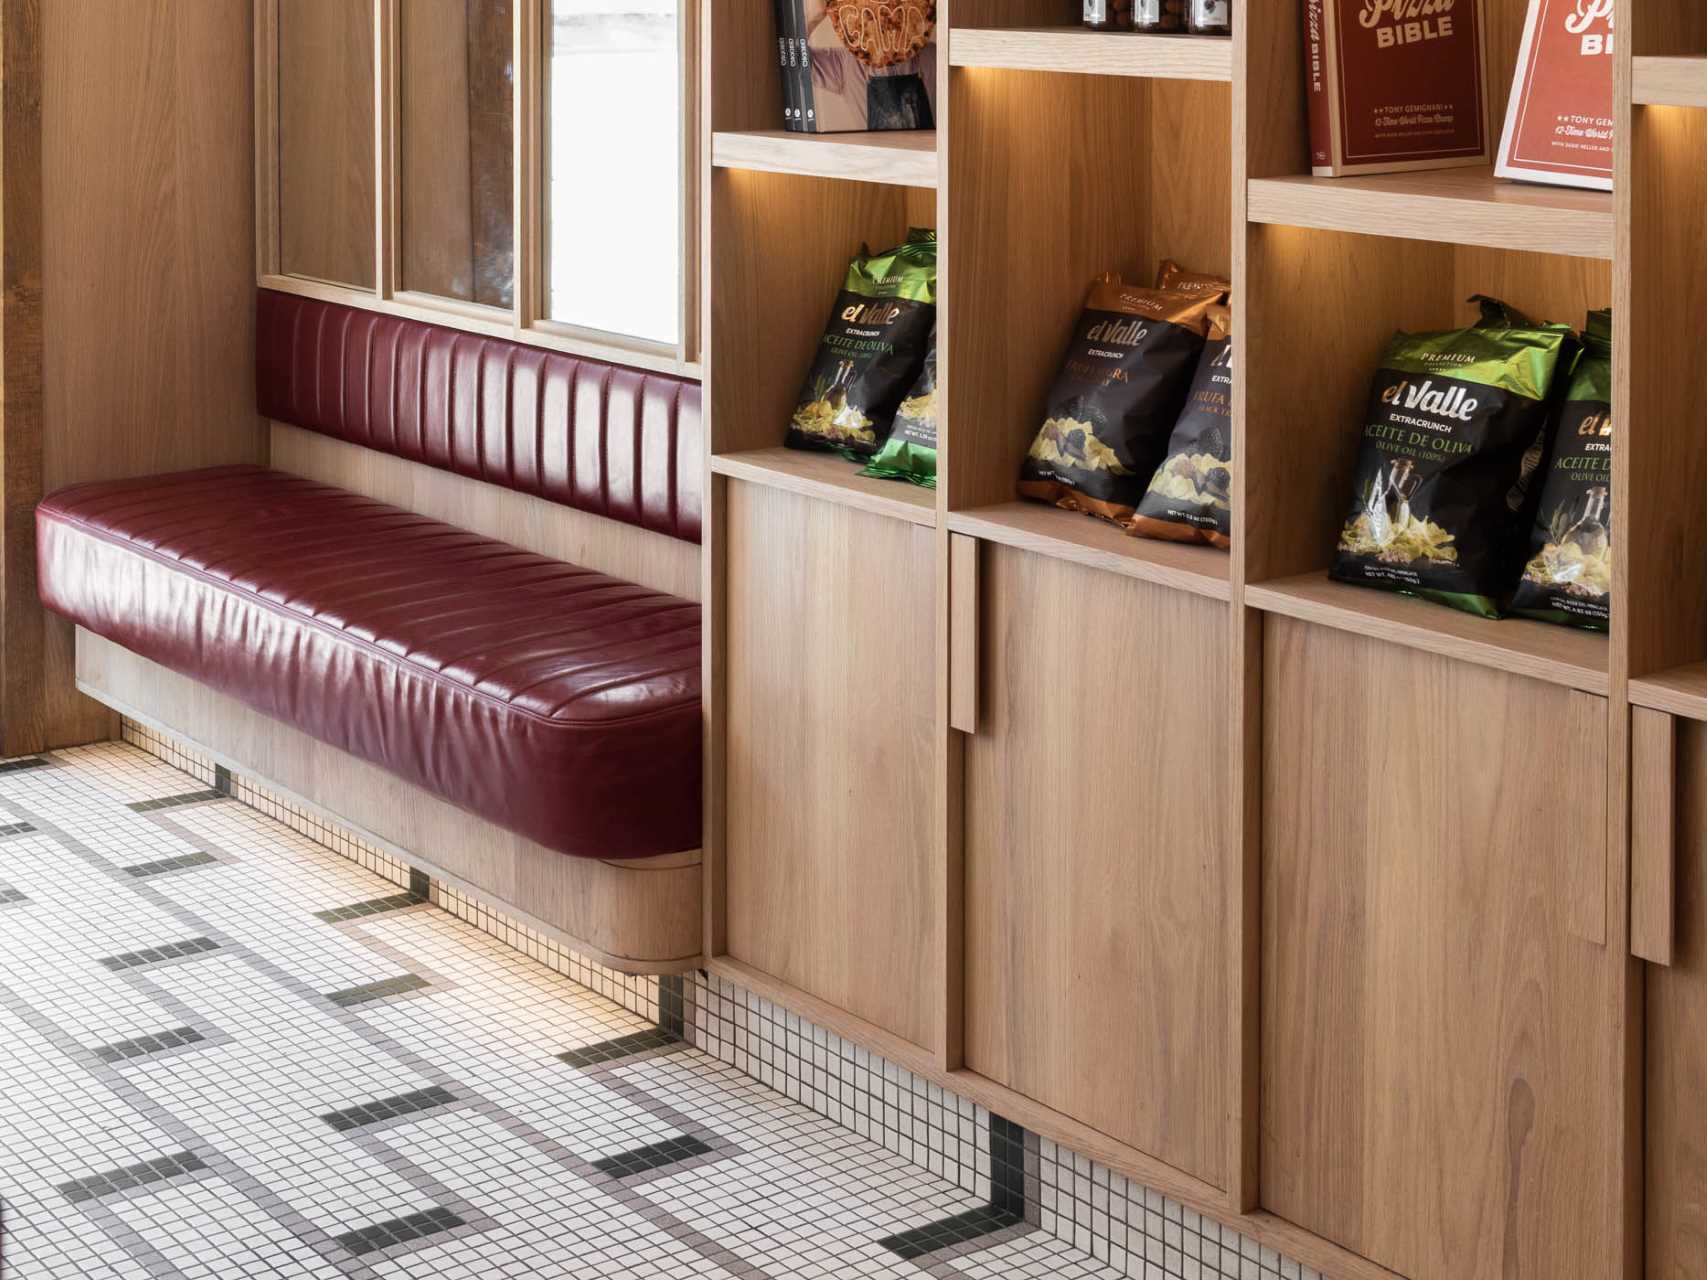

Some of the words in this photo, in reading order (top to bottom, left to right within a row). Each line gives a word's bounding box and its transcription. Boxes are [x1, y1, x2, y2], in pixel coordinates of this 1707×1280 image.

[838, 4, 926, 54] CAMP
[1376, 16, 1453, 49] BIBLE
[1311, 42, 1322, 94] BIBLE
[1384, 106, 1404, 114] TONY
[1571, 115, 1594, 124] TONY
[841, 303, 865, 322] el
[1087, 320, 1109, 341] el
[1104, 319, 1148, 347] Valle
[1421, 351, 1477, 363] PREMIUM
[1381, 380, 1409, 406] el
[1404, 380, 1479, 422] Valle
[1389, 412, 1453, 434] EXTRACRUNCH
[1578, 416, 1600, 435] el
[1408, 431, 1430, 448] DE
[1431, 437, 1474, 455] OLIVA
[1585, 443, 1612, 452] EXTRA
[1553, 456, 1600, 470] ACEITE
